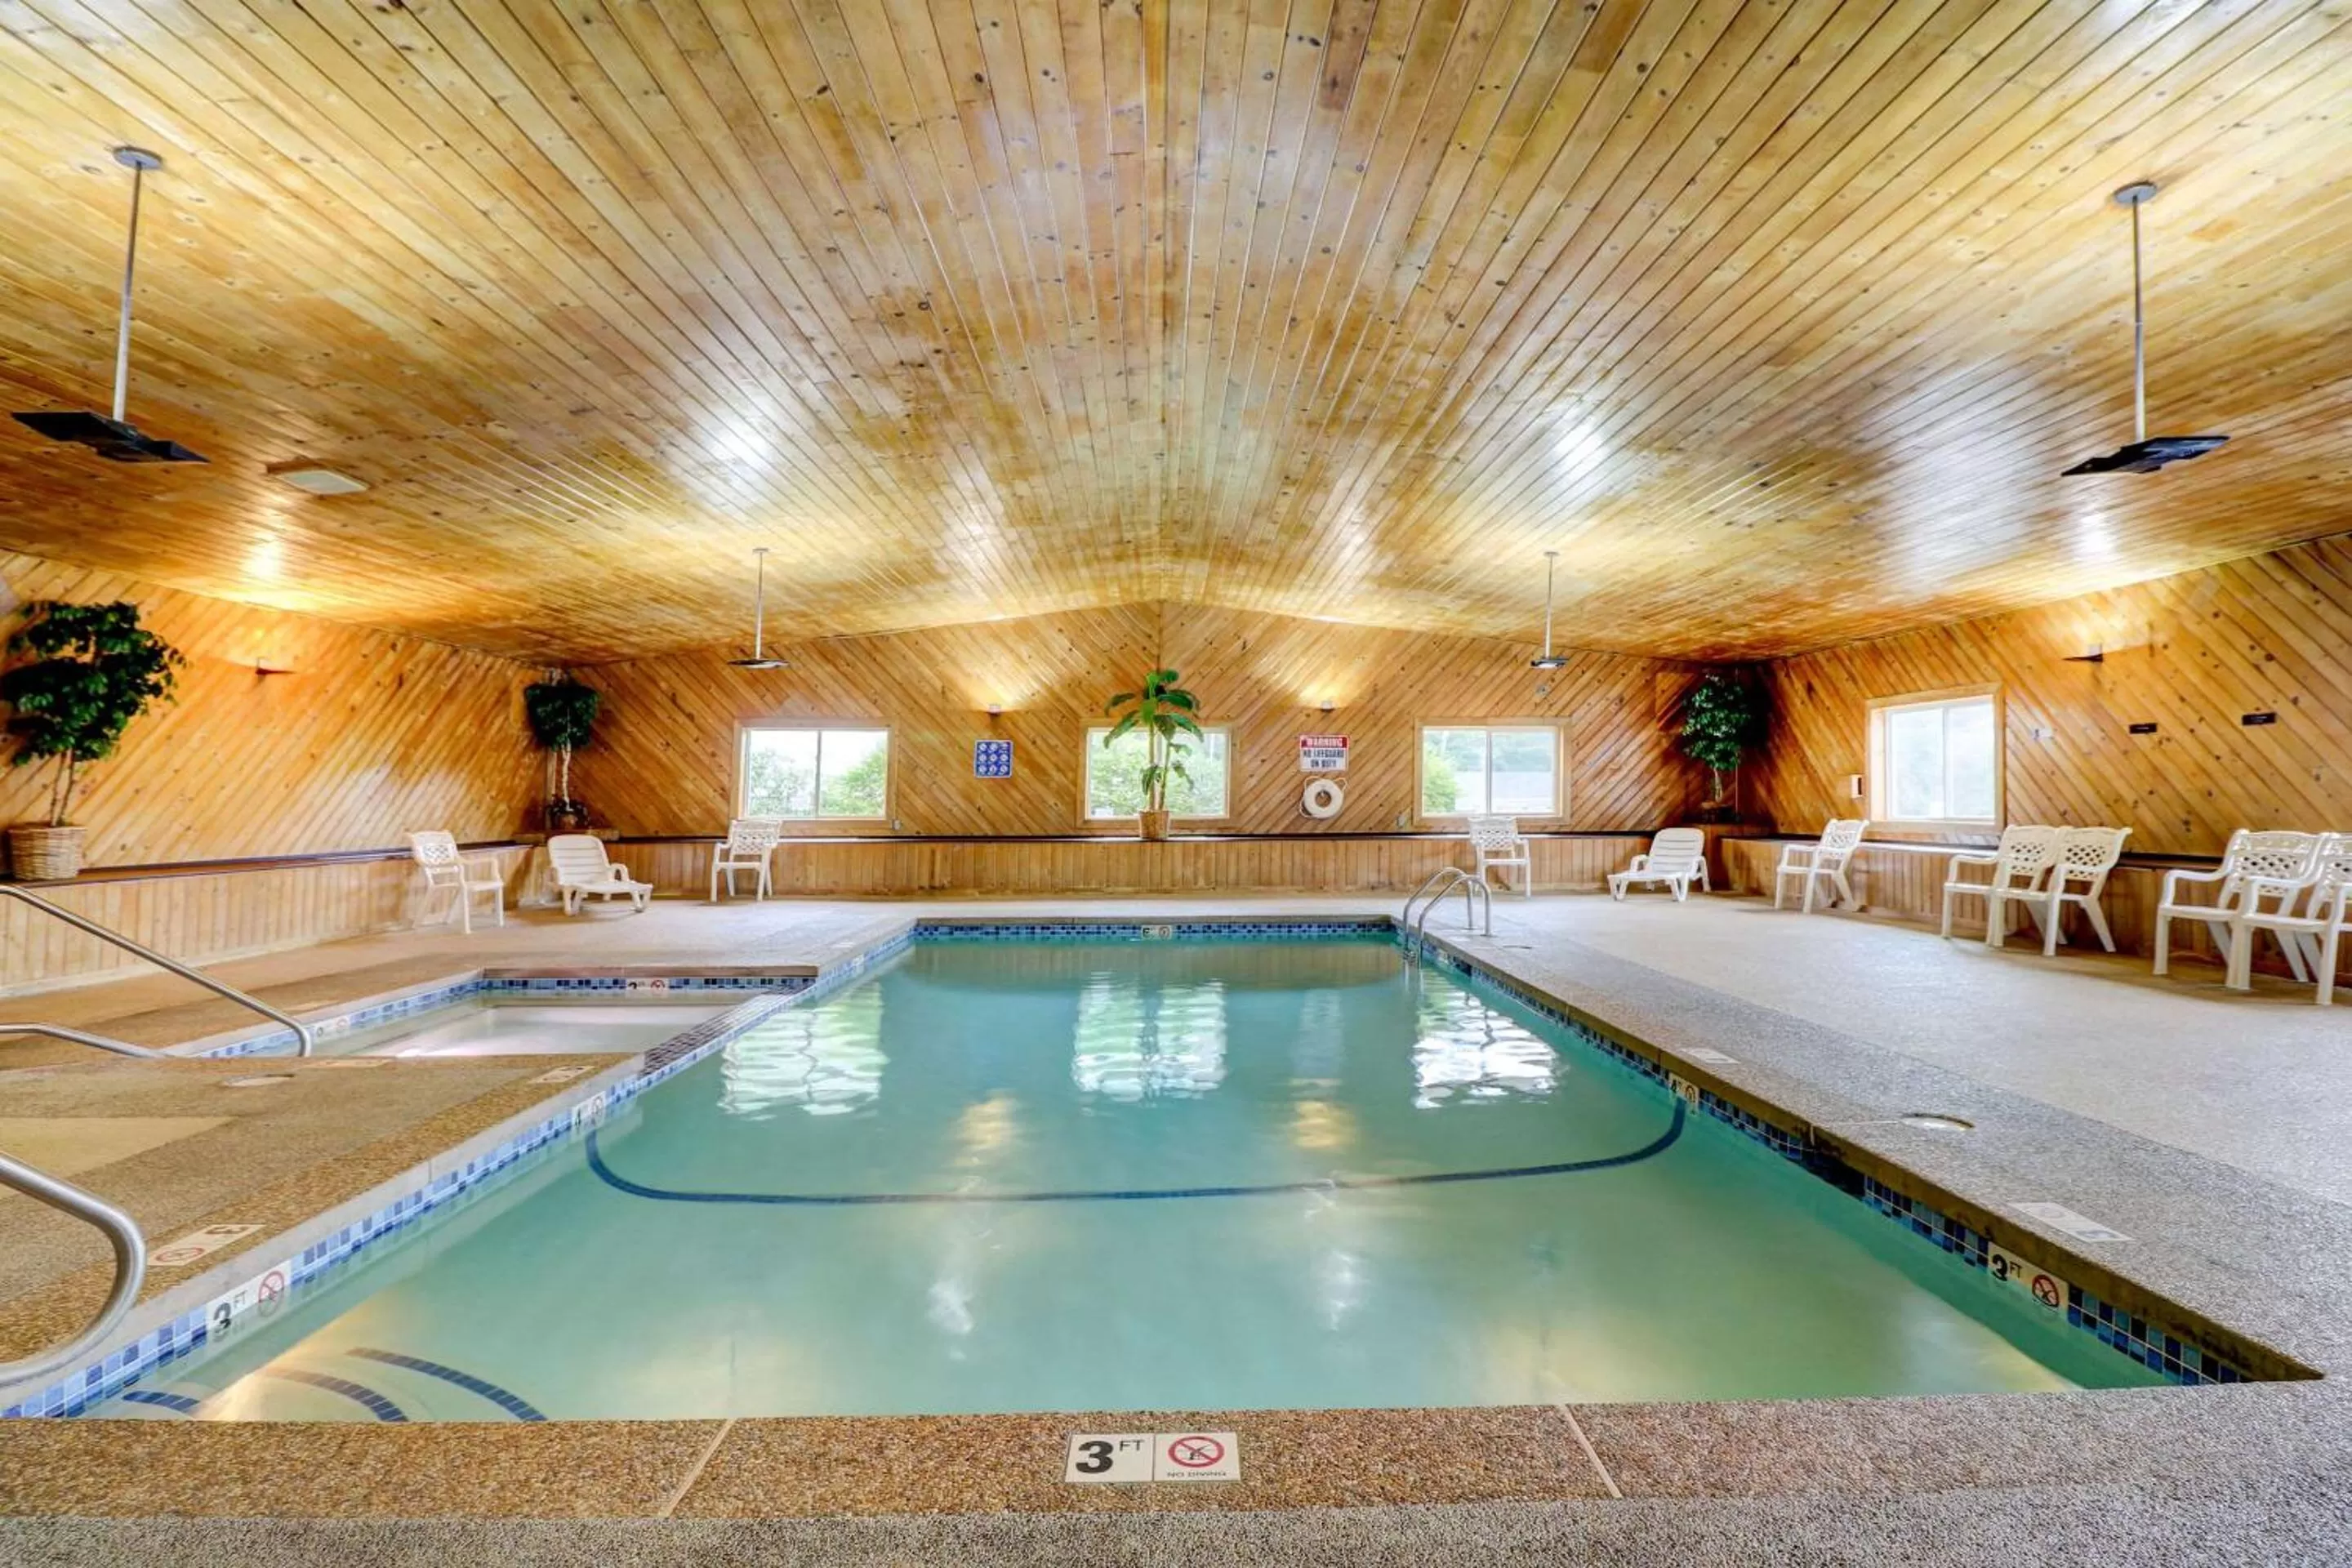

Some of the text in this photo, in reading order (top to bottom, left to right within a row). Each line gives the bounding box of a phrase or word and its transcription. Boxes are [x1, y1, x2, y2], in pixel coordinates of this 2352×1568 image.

[1306, 737, 1343, 747] WARNING
[1313, 749, 1344, 758] LIFEGUARD
[2009, 1260, 2023, 1279] FT
[234, 1290, 248, 1308] FT
[1076, 1439, 1145, 1474] 3 FT
